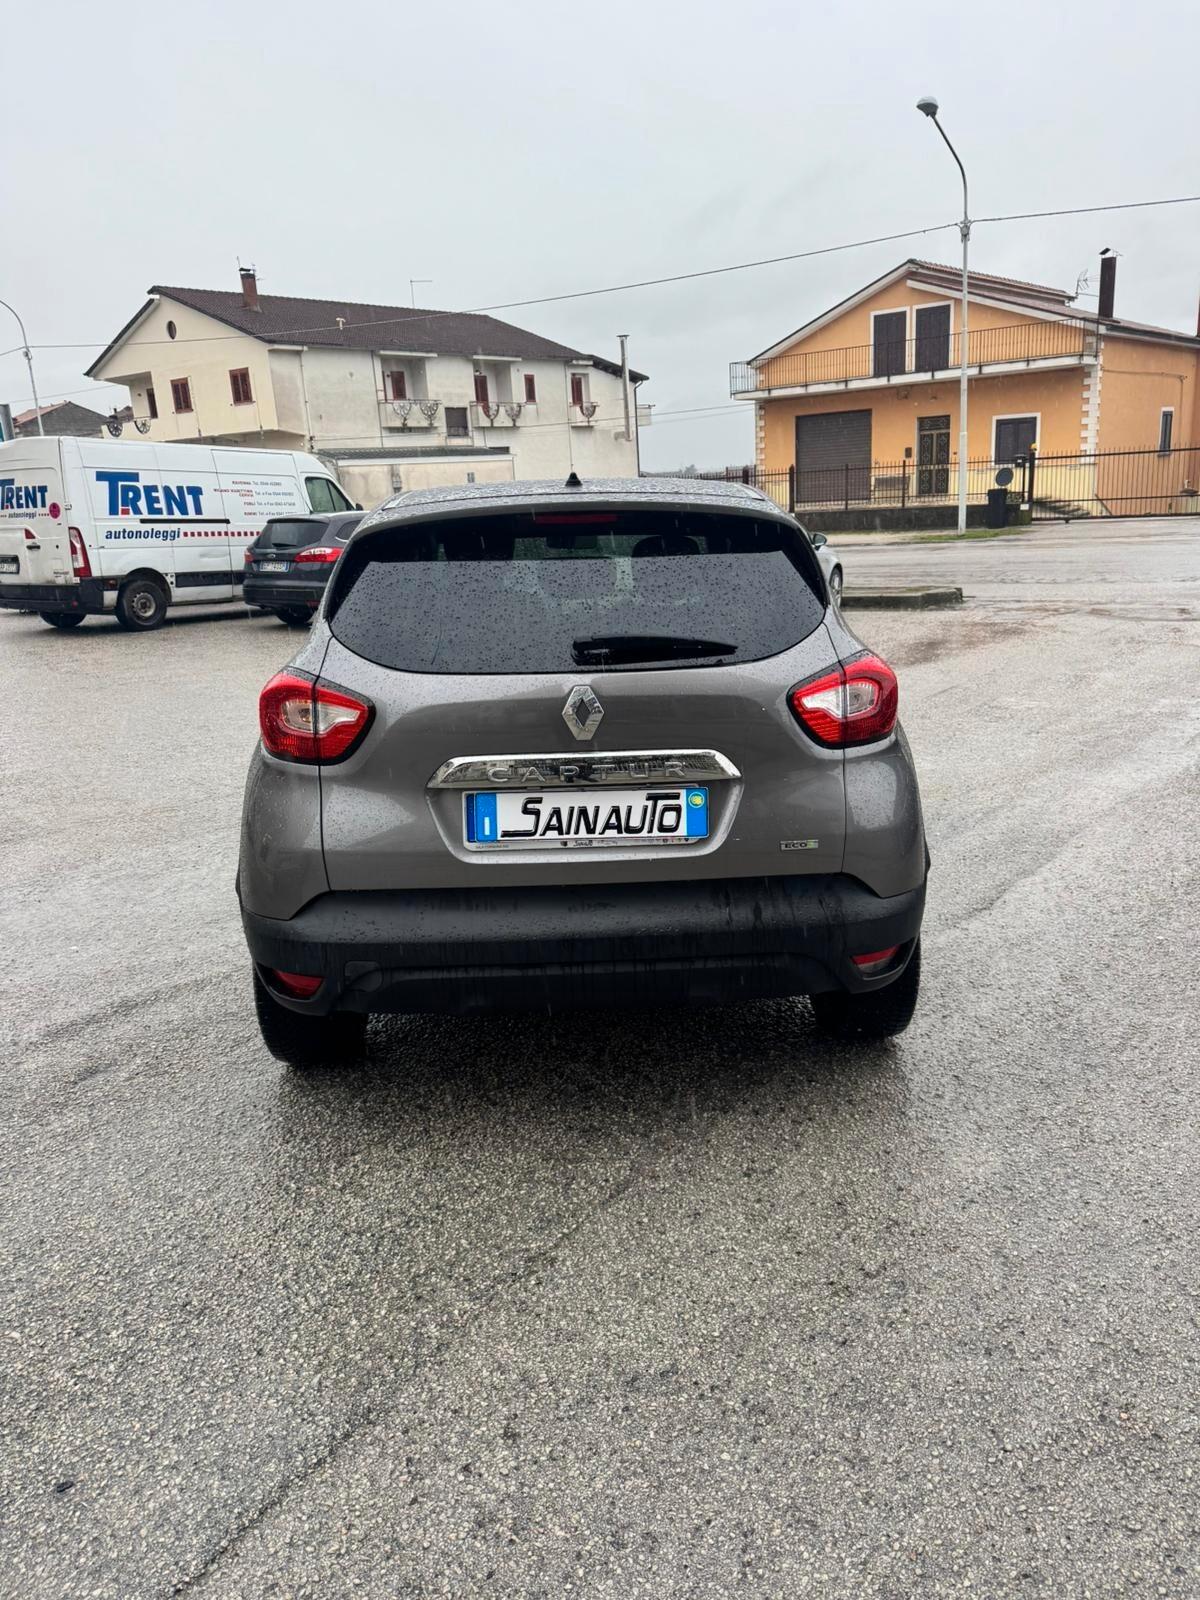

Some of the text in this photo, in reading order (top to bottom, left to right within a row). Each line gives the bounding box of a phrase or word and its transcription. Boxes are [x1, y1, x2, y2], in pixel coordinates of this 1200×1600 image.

[0, 478, 48, 510] TRENT
[96, 471, 204, 516] TRENT
[105, 528, 180, 541] autonoleggi
[487, 761, 687, 783] CAPTUR
